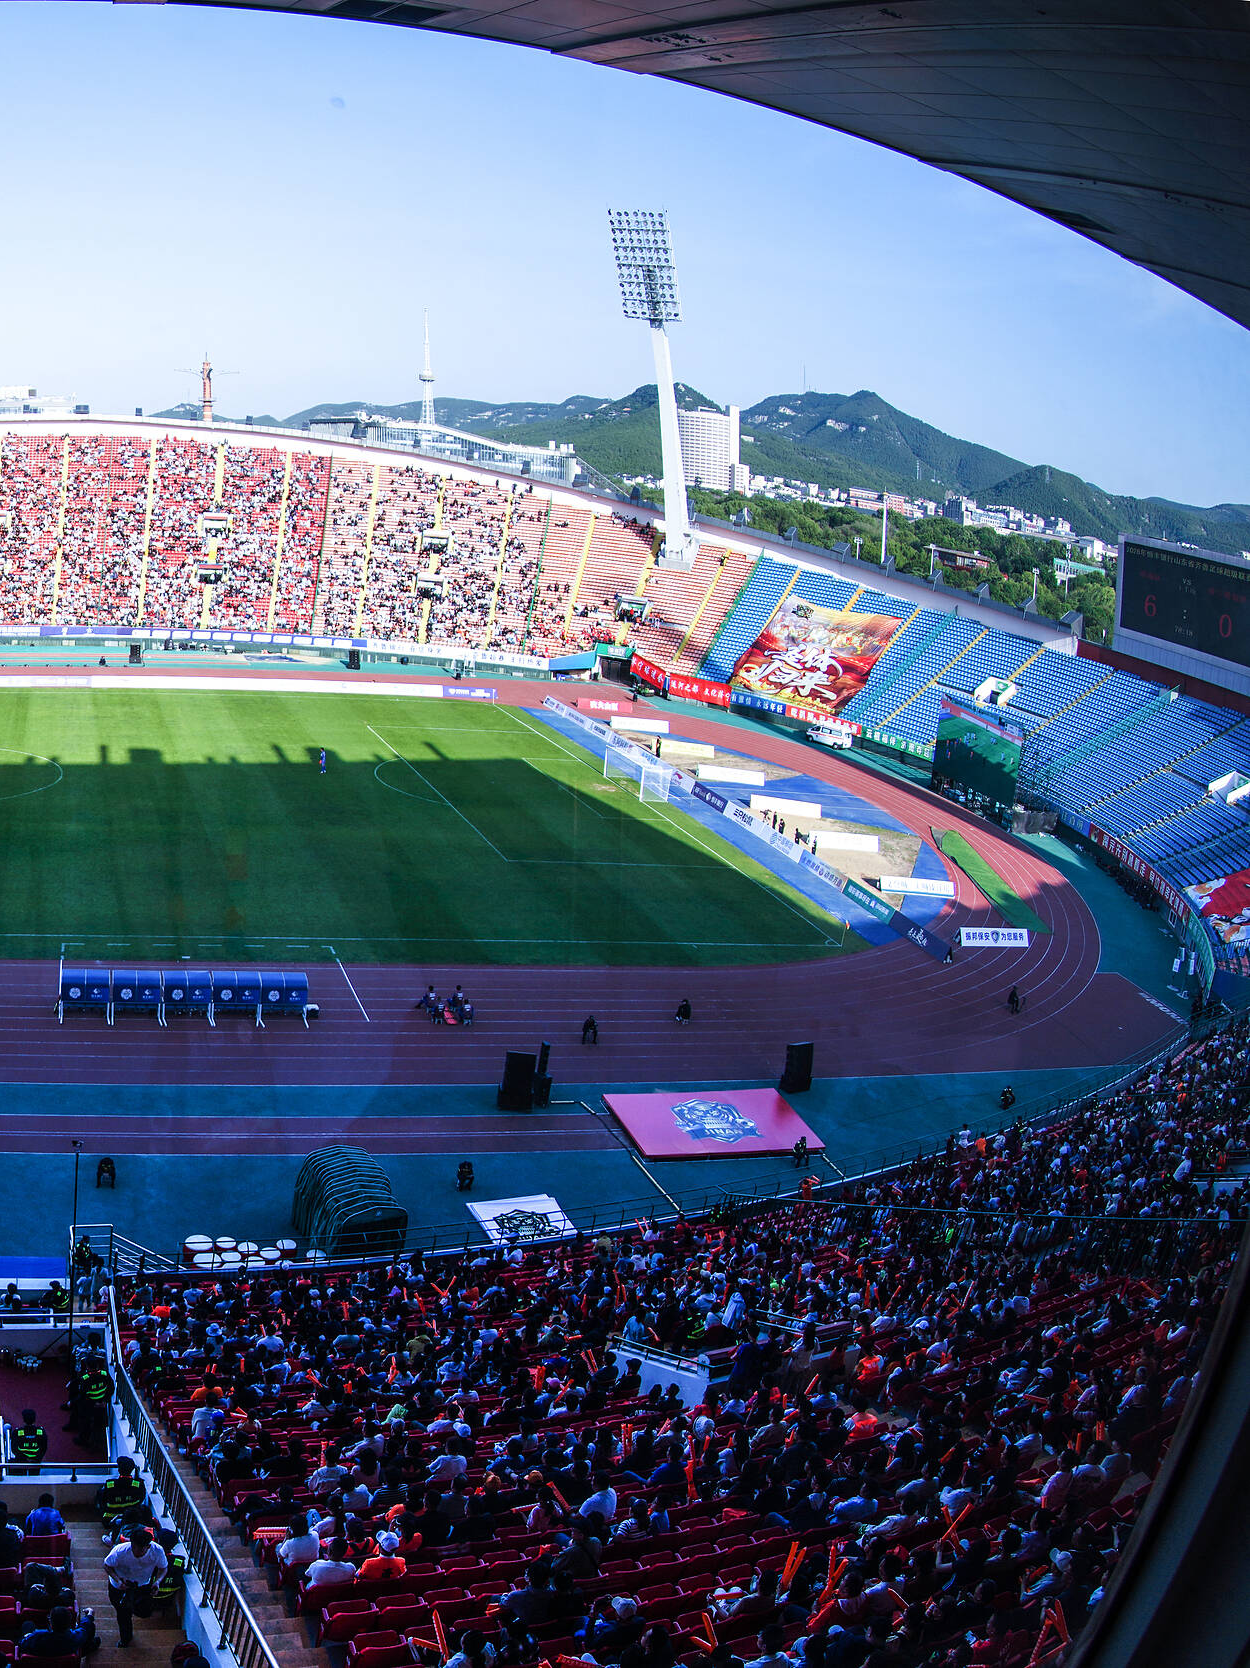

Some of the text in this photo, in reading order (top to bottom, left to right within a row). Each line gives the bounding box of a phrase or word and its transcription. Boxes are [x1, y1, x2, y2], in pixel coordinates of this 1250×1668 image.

[1144, 594, 1157, 617] 6
[1219, 613, 1232, 638] 0
[965, 931, 1025, 942] 振邦保安 为您服务
